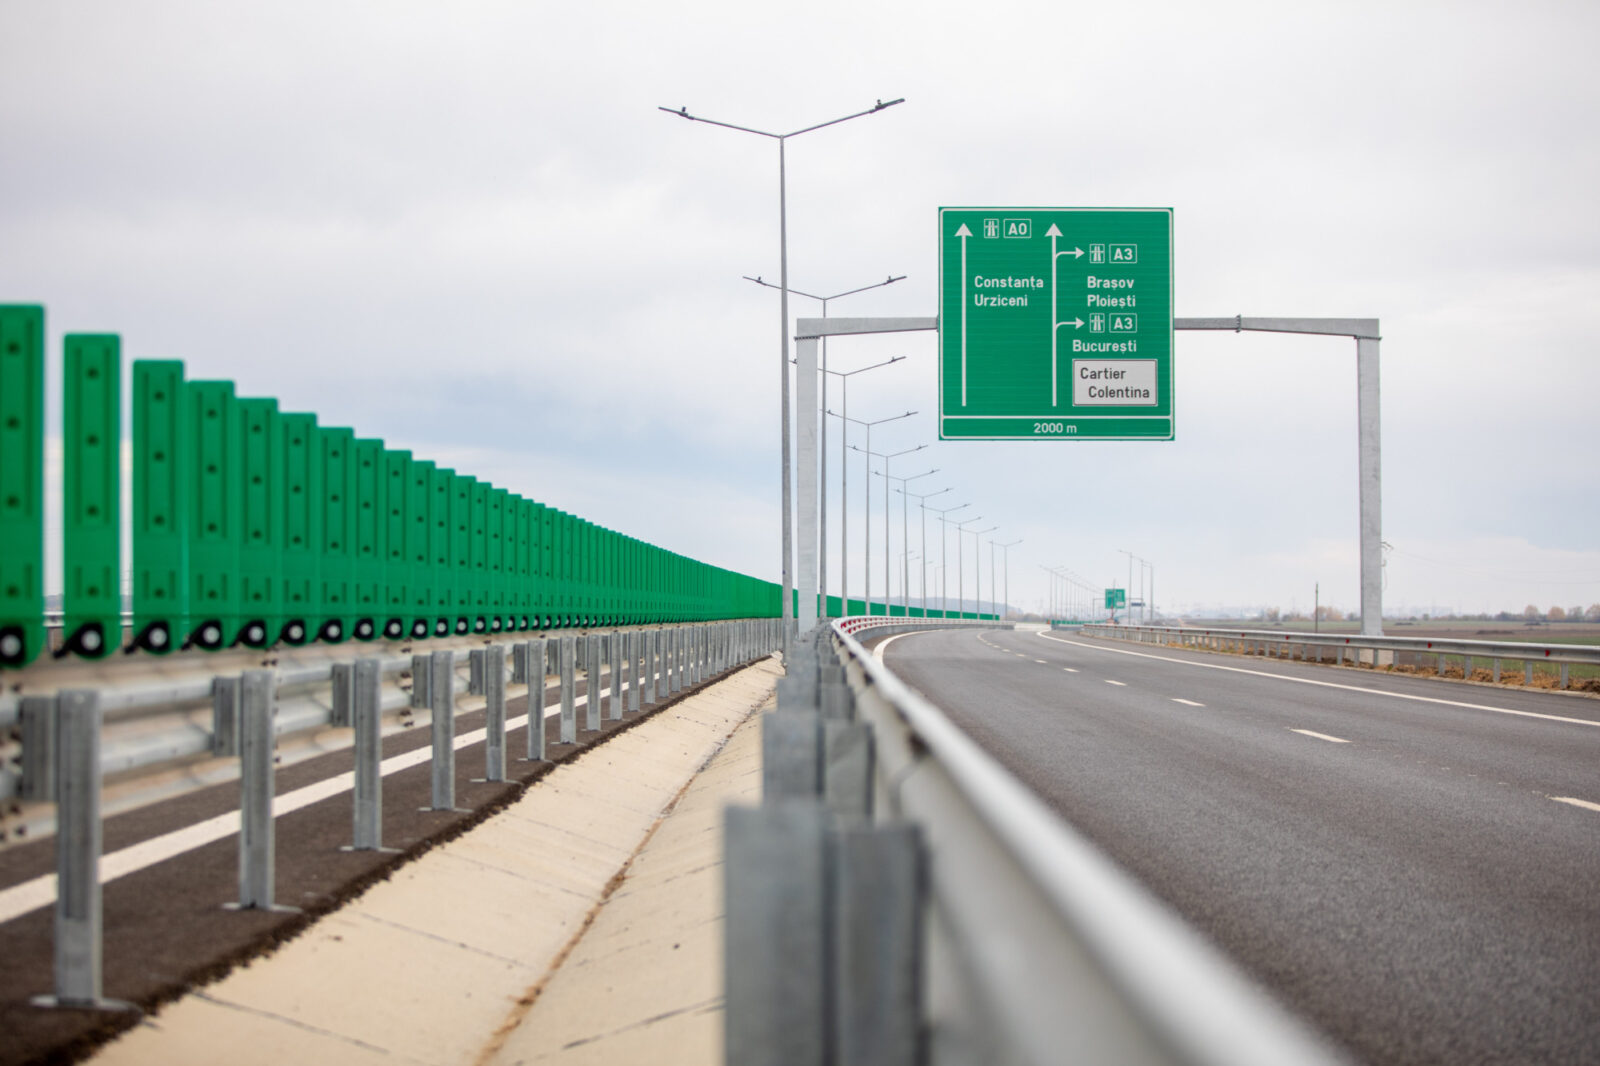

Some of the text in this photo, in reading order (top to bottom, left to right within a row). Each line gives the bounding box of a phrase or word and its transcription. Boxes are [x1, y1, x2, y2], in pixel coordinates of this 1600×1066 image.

[1008, 222, 1027, 235] A0
[1113, 248, 1133, 260] A3
[974, 275, 1044, 291] Constanța
[1087, 275, 1135, 290] Brașov
[974, 293, 1028, 307] Urziceni
[1087, 294, 1136, 309] Ploiești
[1113, 317, 1133, 330] A3
[1072, 339, 1137, 354] București
[1080, 367, 1127, 380] Cartier
[1088, 385, 1150, 398] Colentina
[1033, 422, 1077, 434] 2000 m
